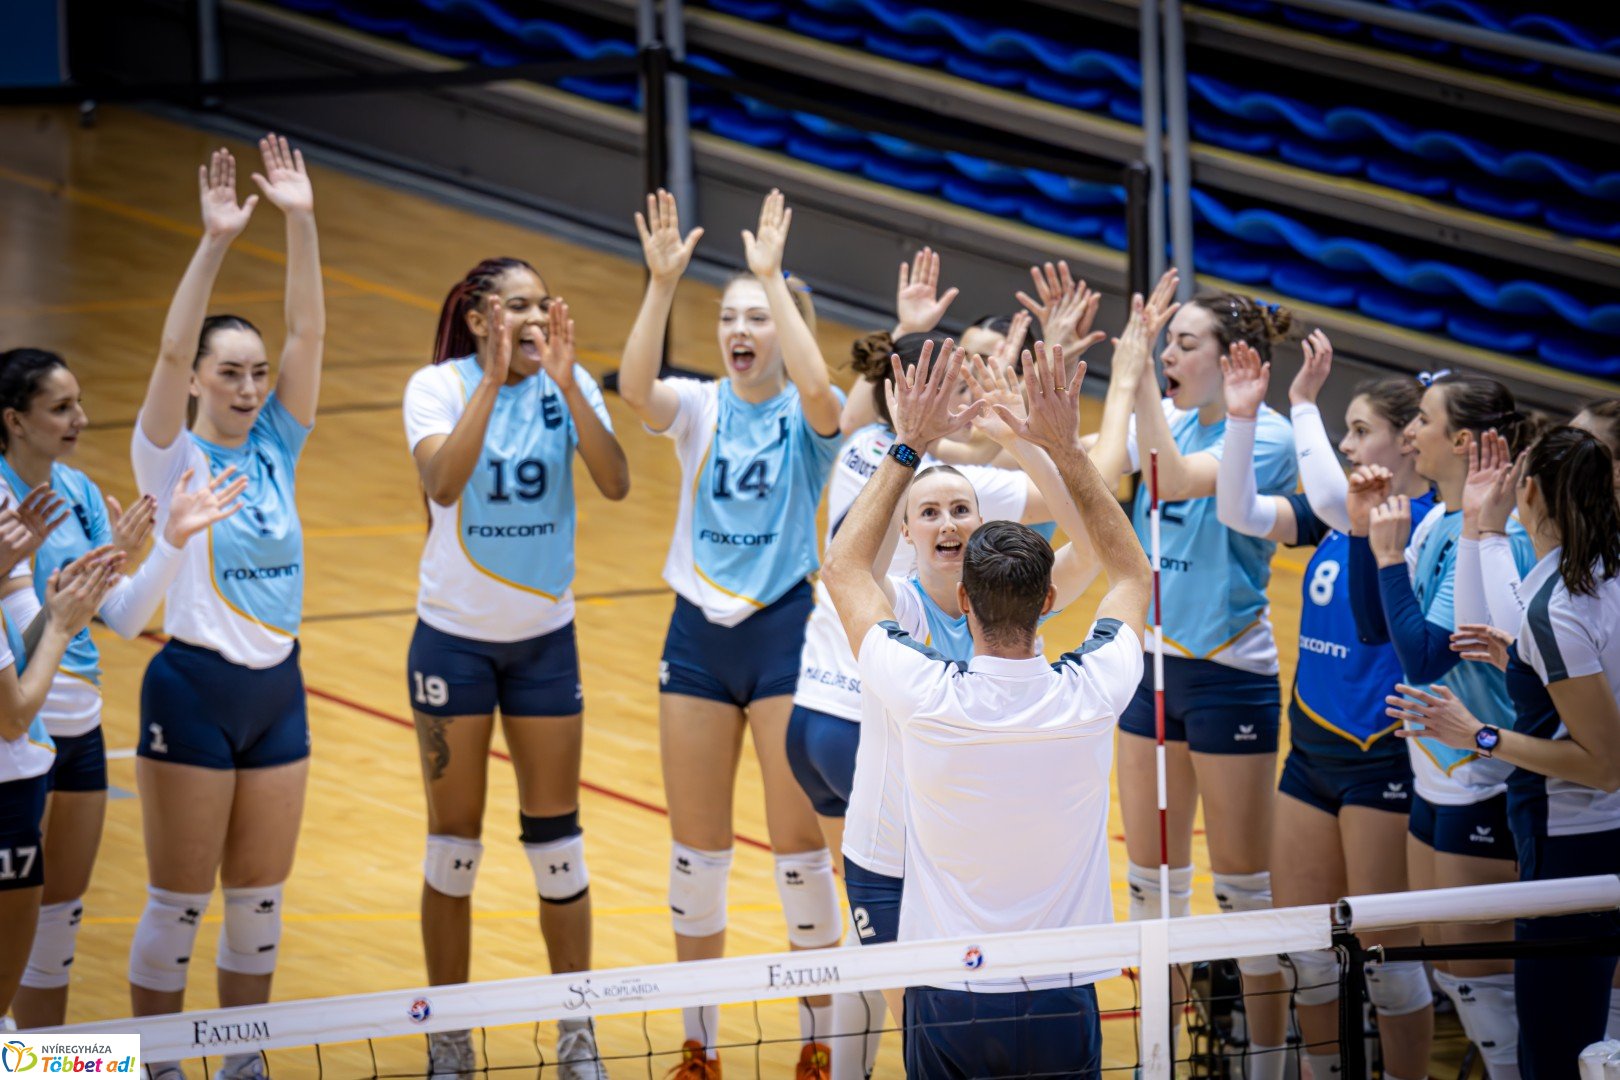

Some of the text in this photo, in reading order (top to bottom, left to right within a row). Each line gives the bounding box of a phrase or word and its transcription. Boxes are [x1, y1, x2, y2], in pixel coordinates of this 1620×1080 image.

[487, 459, 547, 504] 19
[713, 457, 772, 500] 14
[1309, 559, 1340, 607] 8
[414, 670, 449, 707] 19
[149, 722, 168, 754] 1
[0, 846, 37, 880] 17
[854, 906, 876, 939] 2
